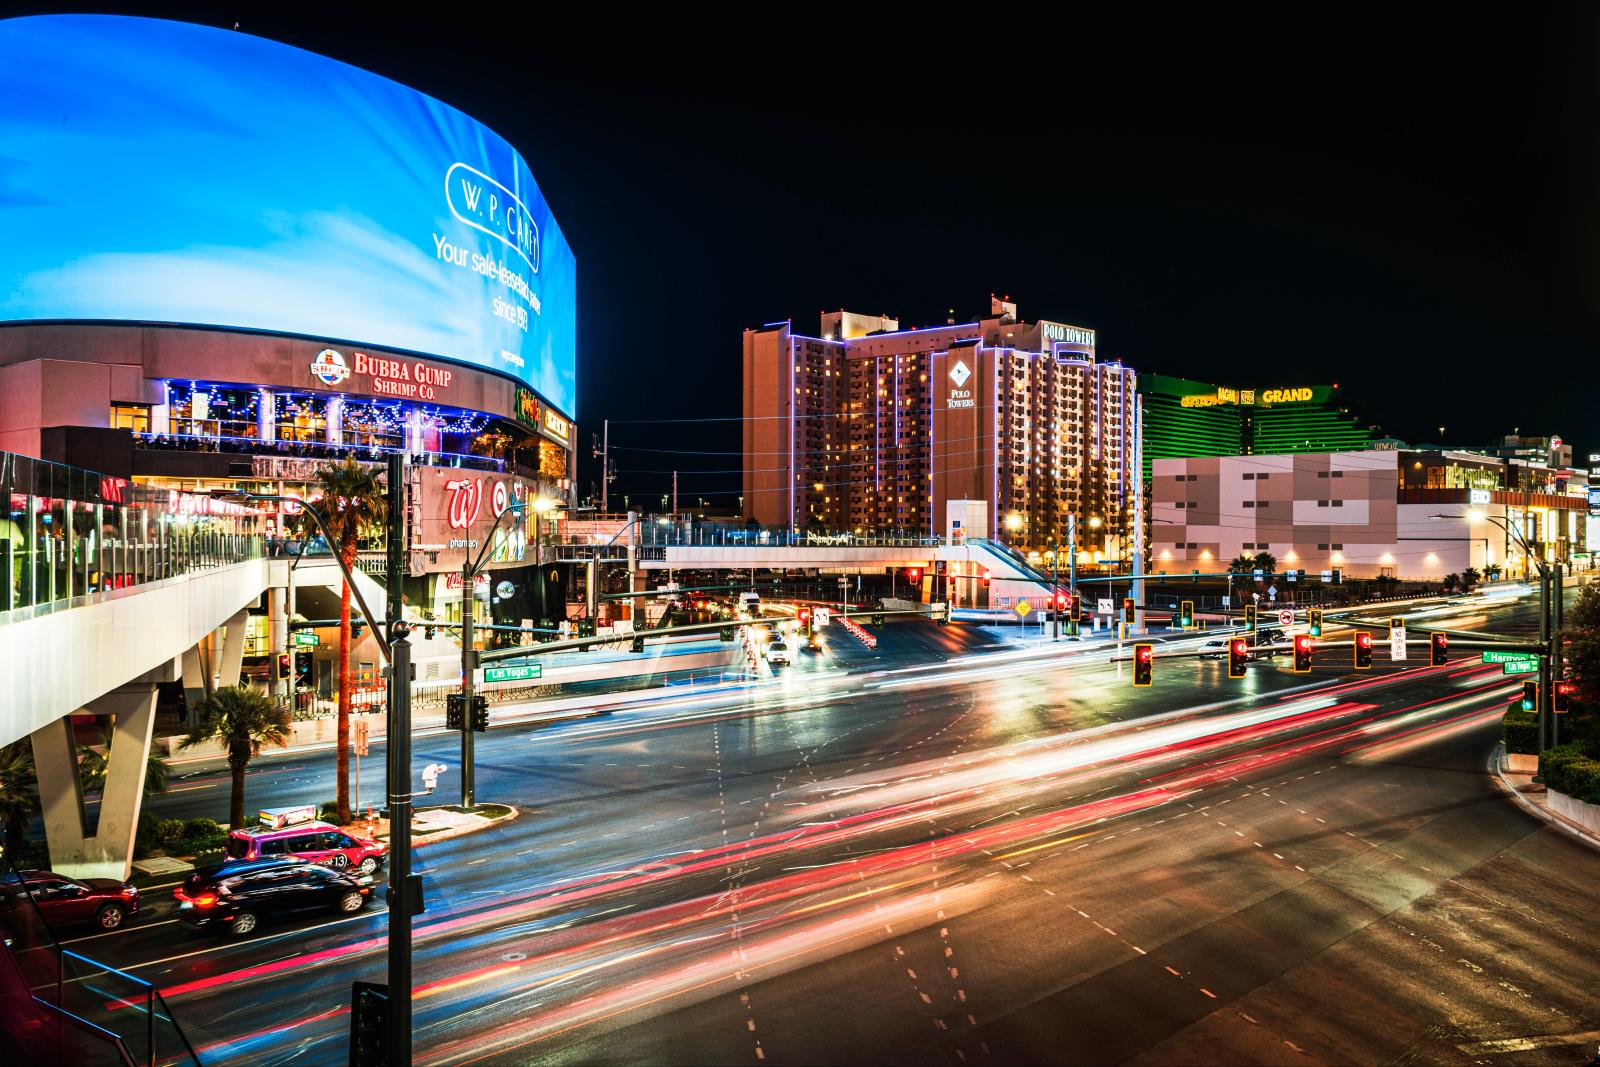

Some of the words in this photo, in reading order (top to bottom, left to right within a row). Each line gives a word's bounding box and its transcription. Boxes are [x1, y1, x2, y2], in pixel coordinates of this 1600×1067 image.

[432, 232, 468, 266] Your
[492, 295, 516, 325] since
[1043, 325, 1064, 341] POLO
[1066, 328, 1095, 346] TOWERS
[353, 352, 411, 381] BUBBA
[414, 362, 452, 387] GUMP
[373, 378, 417, 397] SHRIMP
[419, 384, 435, 400] CO.
[951, 389, 970, 399] POLO
[1262, 388, 1313, 403] GRAND
[947, 399, 974, 409] TOWERS
[492, 670, 505, 679] Las
[506, 669, 529, 680] Vegas
[335, 856, 344, 867] 13
